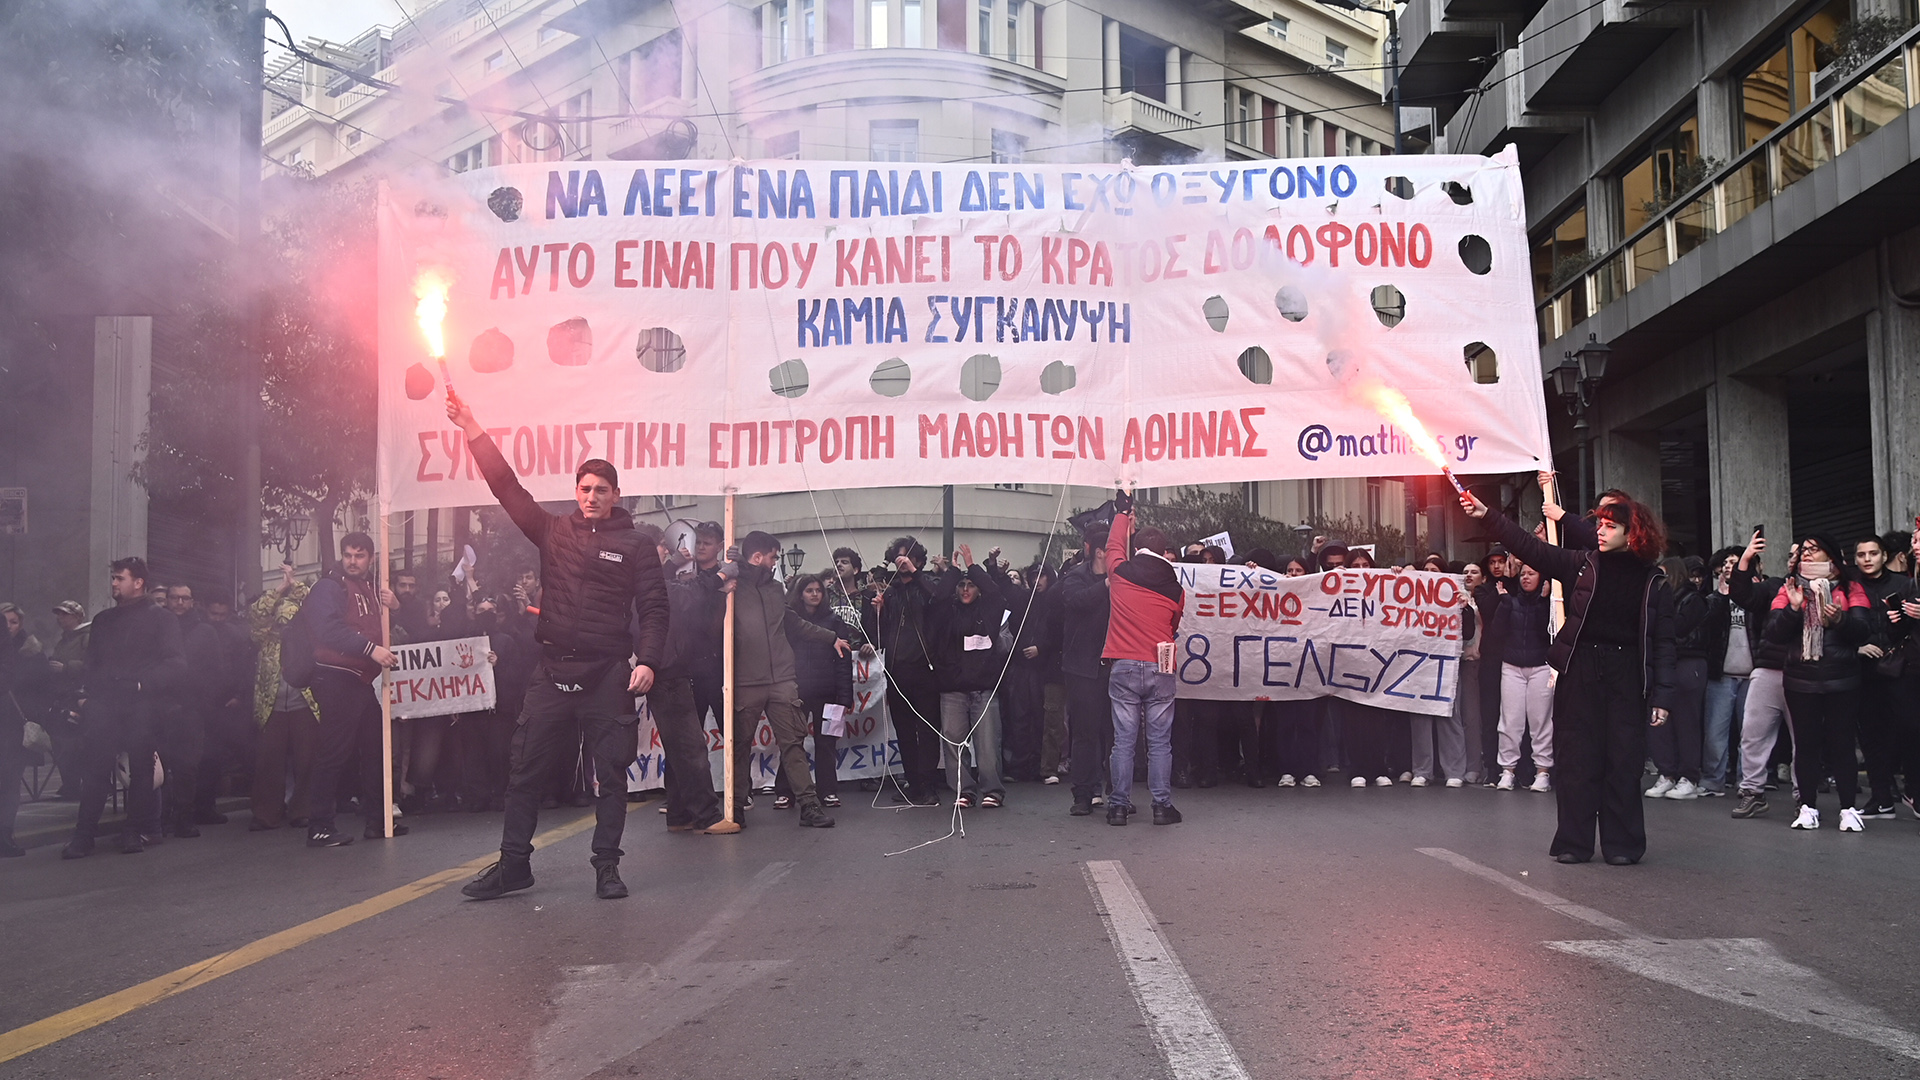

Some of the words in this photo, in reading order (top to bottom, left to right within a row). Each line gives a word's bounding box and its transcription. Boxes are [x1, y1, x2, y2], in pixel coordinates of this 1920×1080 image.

[545, 170, 608, 219] ΝΑ
[623, 169, 719, 218] ΛΕΕΙ
[733, 164, 816, 219] ΕΝΑ
[829, 169, 943, 219] ΠΑΙΔΙ
[959, 170, 1045, 212] ΔΕΝ
[1151, 163, 1358, 208] ΟΞΥΓΟΝΟ
[490, 241, 595, 300] ΑΥΤΟ
[614, 239, 715, 290] ΕΙΝΑΙ
[730, 241, 818, 291] ΠΟΥ
[836, 235, 951, 287] ΚΑΝΕΙ
[974, 234, 1023, 282] ΤΟ
[1042, 234, 1188, 287] ΚΡΑΤΟΣ
[798, 296, 908, 348] ΚΑΜΙΑ
[924, 295, 1131, 344] ΣΥΓΚΑΛΥΨΗ
[709, 415, 895, 469] ΕΠΙΤΡΟΠΗ
[918, 412, 1106, 461] ΜΑΘΗΤΩΝ
[1121, 407, 1268, 463] ΑΘΗΝΑΣ
[1297, 423, 1480, 462] @mathis.gr
[1195, 592, 1303, 625] ΞΕΧΝΩ
[1220, 568, 1278, 590] ΕΧΩ
[1321, 572, 1459, 608] ΟΞΥΓΟΝΟ
